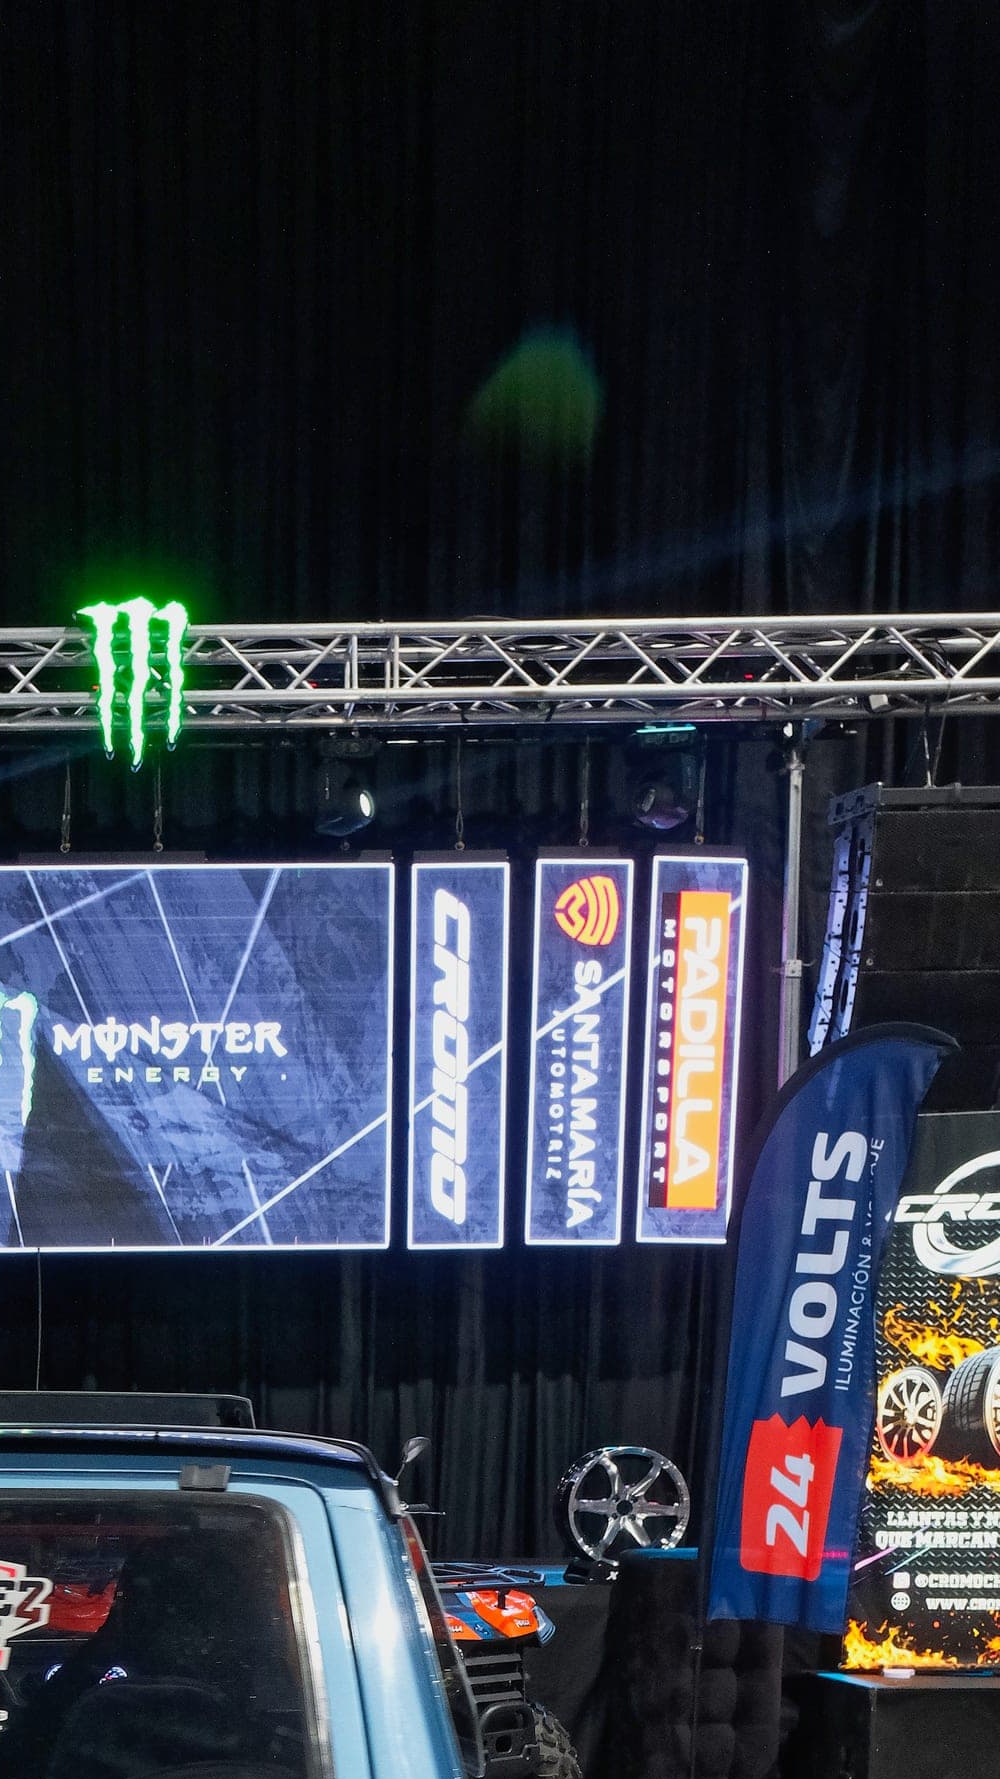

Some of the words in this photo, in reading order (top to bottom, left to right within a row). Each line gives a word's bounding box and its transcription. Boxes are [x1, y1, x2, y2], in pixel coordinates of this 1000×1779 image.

[52, 1015, 288, 1062] MONSTER
[87, 1065, 248, 1083] ENERGY
[430, 888, 472, 1225] CROMO
[566, 959, 602, 1228] SANTAMARÍA
[652, 918, 678, 1184] MOTORSPORT
[672, 917, 723, 1186] PADILLA
[781, 1130, 868, 1397] VOLTS
[834, 1252, 871, 1391] ILUMINACIÓN
[766, 1453, 815, 1558] 24
[875, 1531, 913, 1550] QUE
[887, 1511, 968, 1527] LLANTAS
